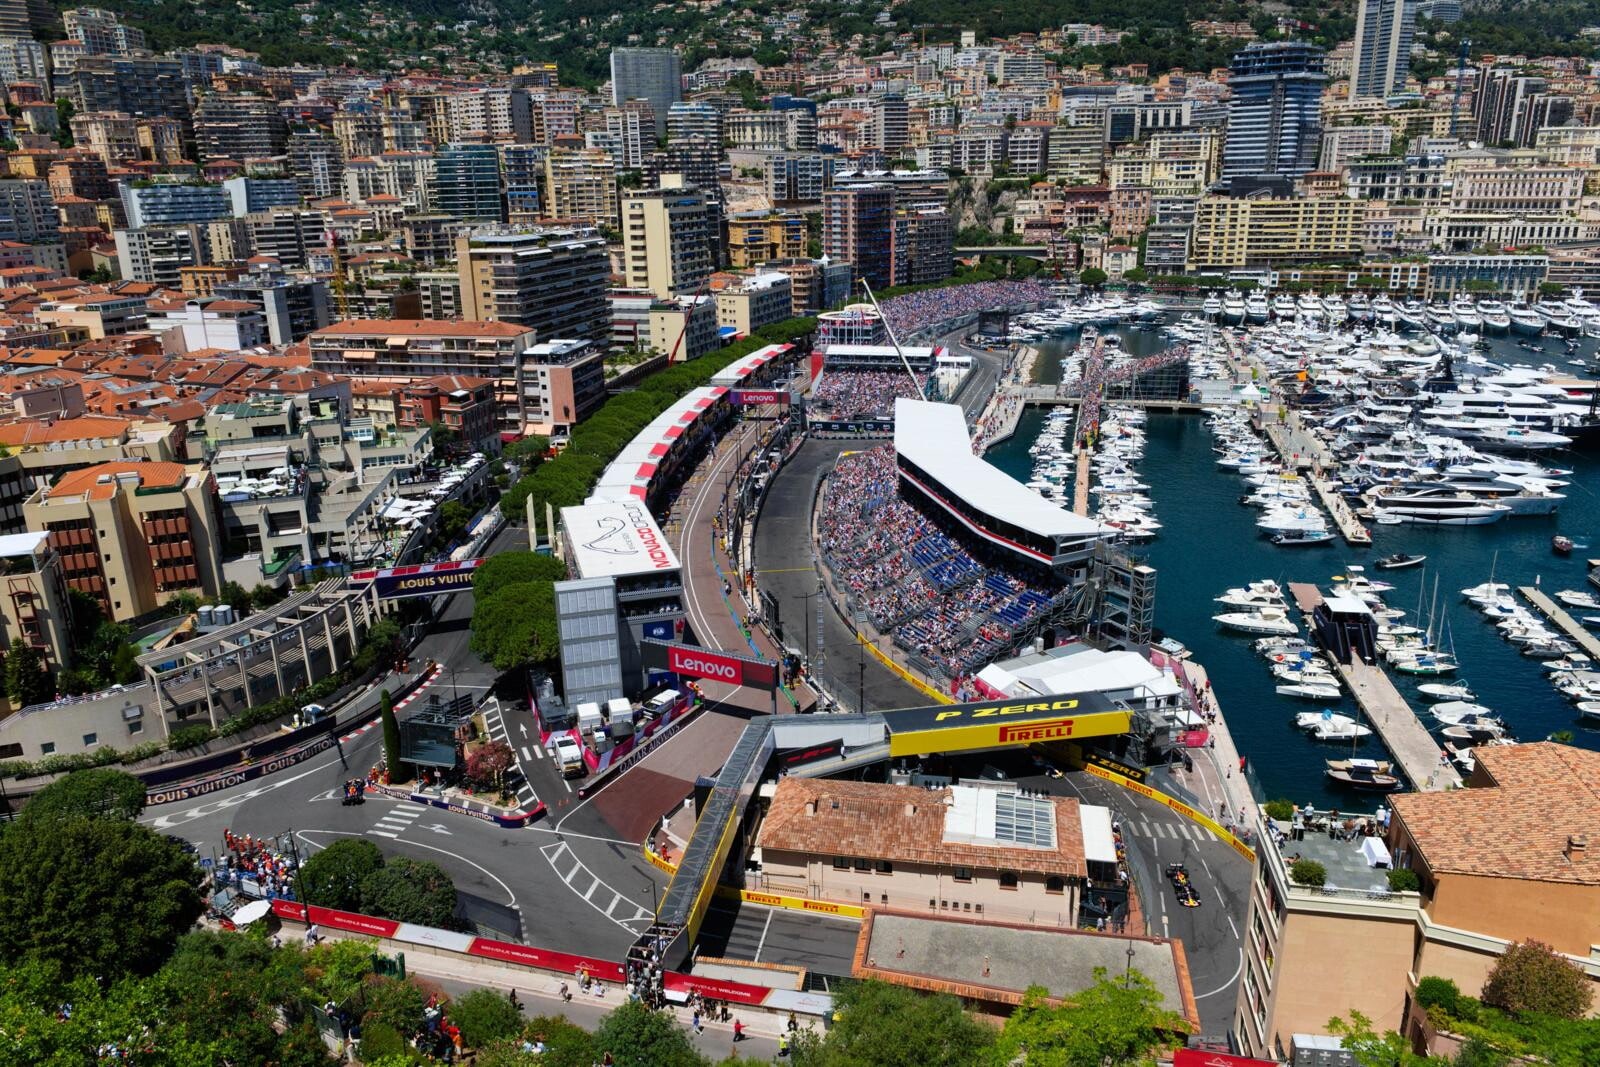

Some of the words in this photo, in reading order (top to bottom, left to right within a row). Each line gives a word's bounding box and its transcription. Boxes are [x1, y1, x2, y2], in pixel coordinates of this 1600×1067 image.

[743, 394, 774, 402] Lenovo
[637, 527, 671, 568] MONACO
[400, 576, 435, 589] LOUIS
[438, 572, 474, 585] VUITTO
[674, 653, 735, 678] Lenovo
[935, 711, 962, 721] P
[972, 699, 1079, 718] ZERO
[998, 720, 1074, 742] PIRELLI
[261, 756, 296, 775] LOUIS
[299, 735, 337, 762] VUITTON
[1098, 757, 1142, 779] ZERO
[147, 788, 188, 806] LOUIS
[191, 773, 246, 796] VUITTON
[448, 805, 467, 816] LOUIS
[467, 809, 494, 822] VUITTON
[718, 988, 751, 998] WELCOME
